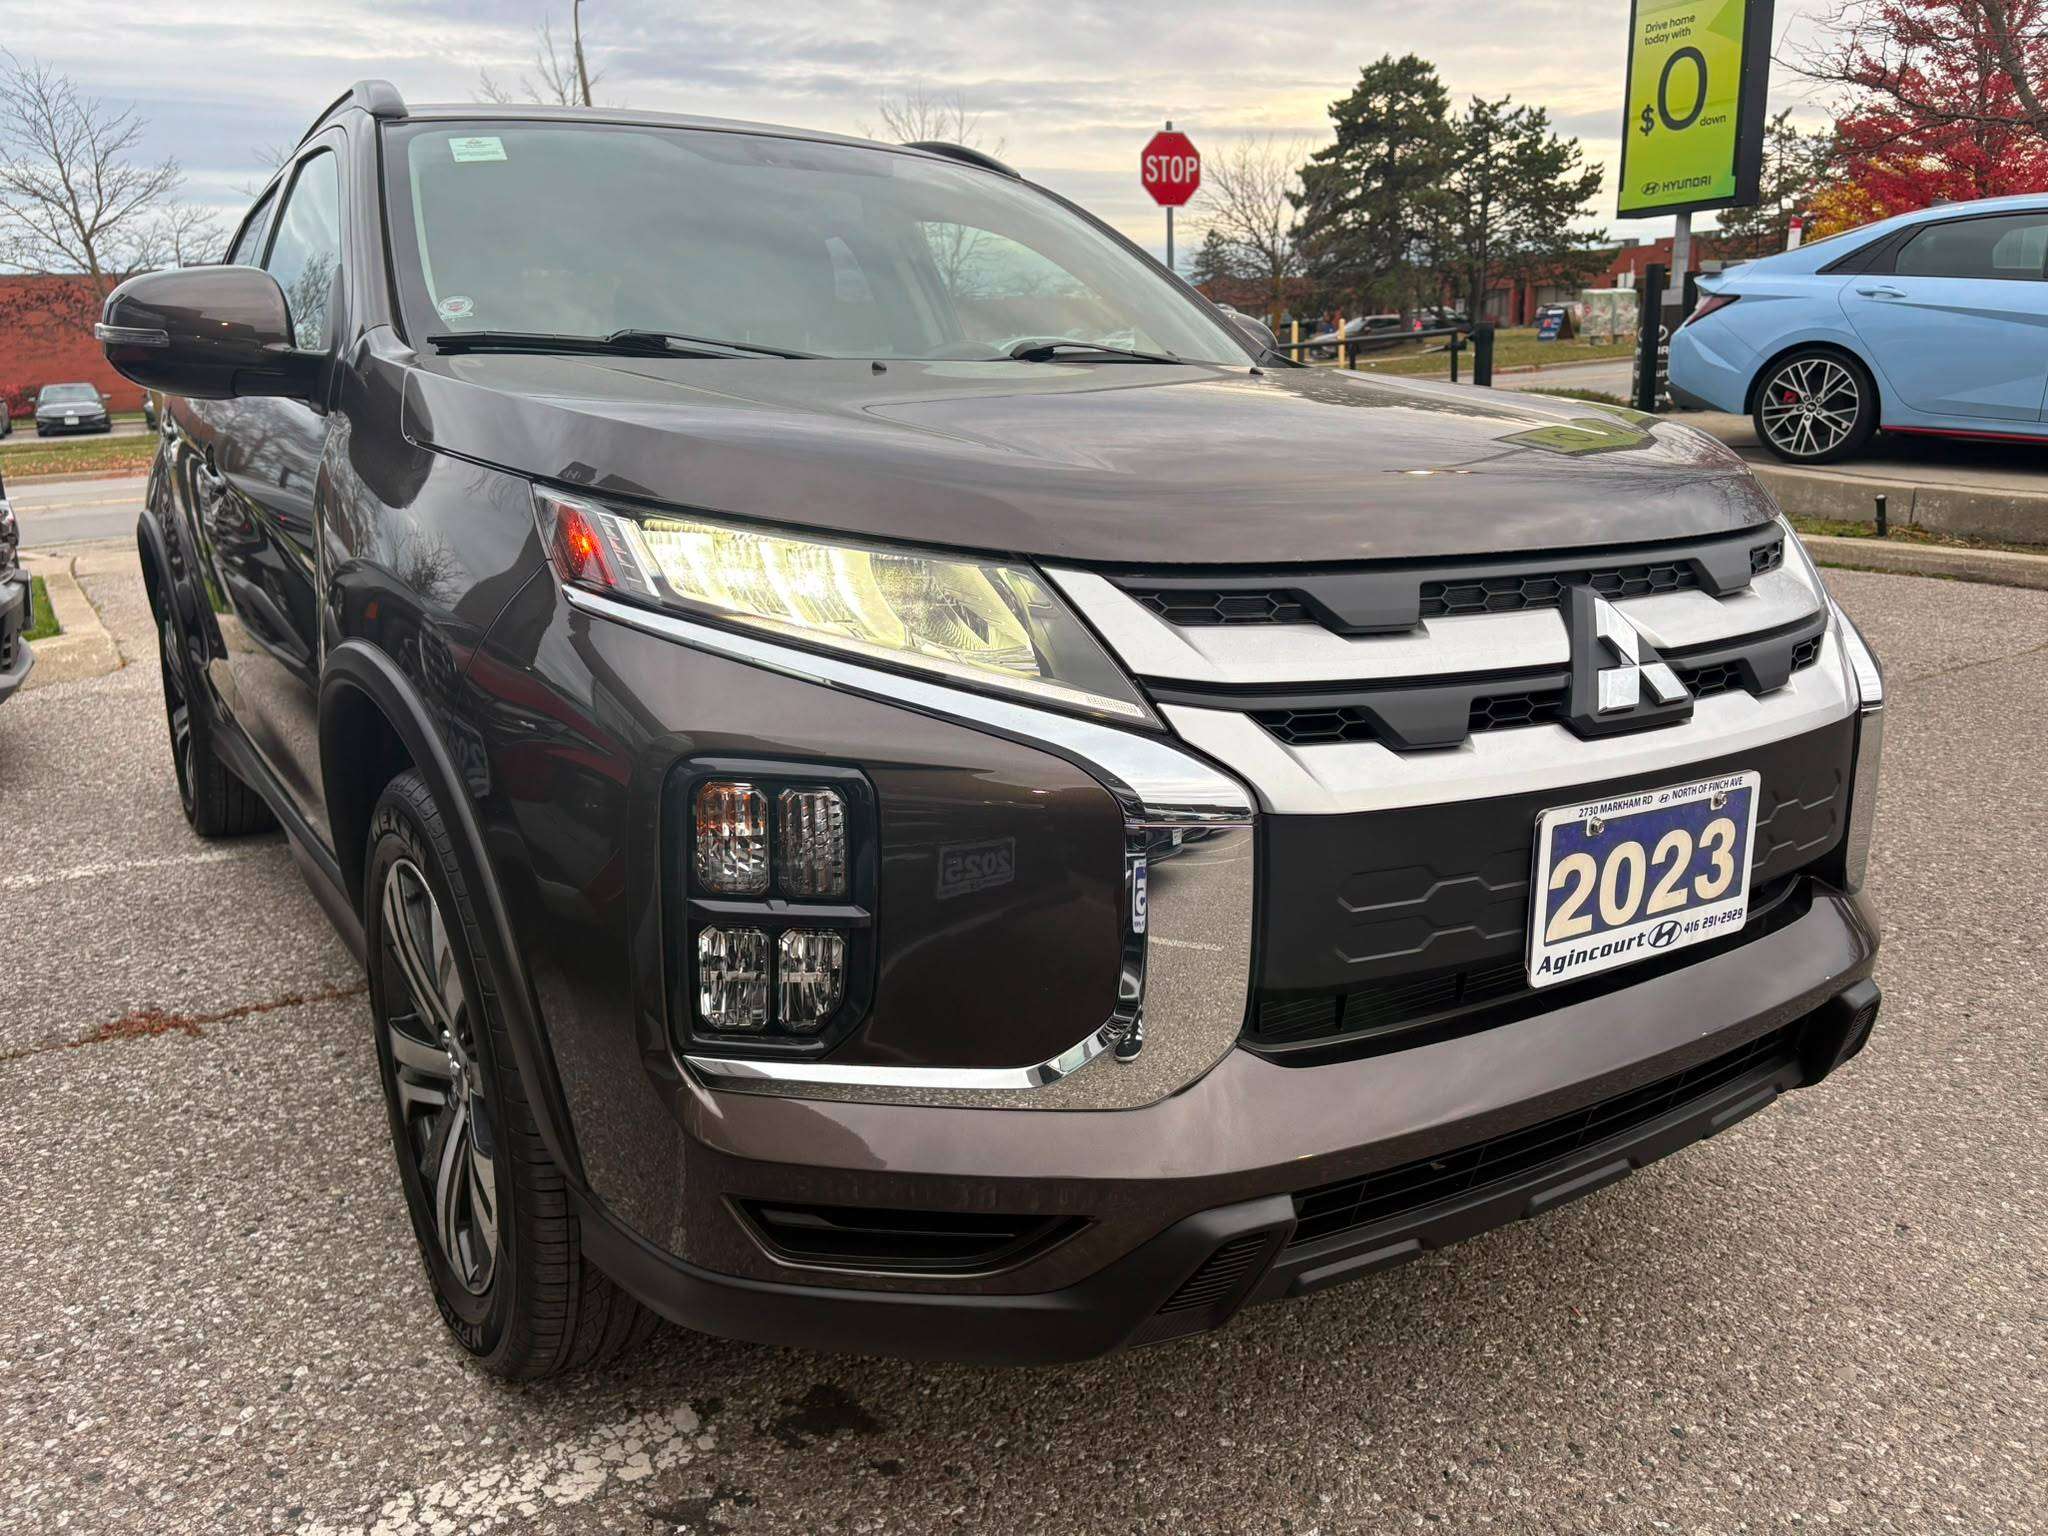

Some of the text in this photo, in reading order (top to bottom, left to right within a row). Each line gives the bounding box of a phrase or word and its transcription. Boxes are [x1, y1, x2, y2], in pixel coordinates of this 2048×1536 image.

[1645, 14, 1696, 34] Drive home
[1644, 27, 1691, 46] today with
[1699, 113, 1727, 127] down
[1145, 155, 1198, 183] STOP
[1662, 175, 1712, 192] HYUNDAI
[1578, 776, 1743, 818] 2730 MARKHAM RD NORTH OF FINCH AVE
[1545, 817, 1736, 943] 2023
[1683, 920, 1700, 933] 416
[1537, 931, 1648, 975] Agincourt
